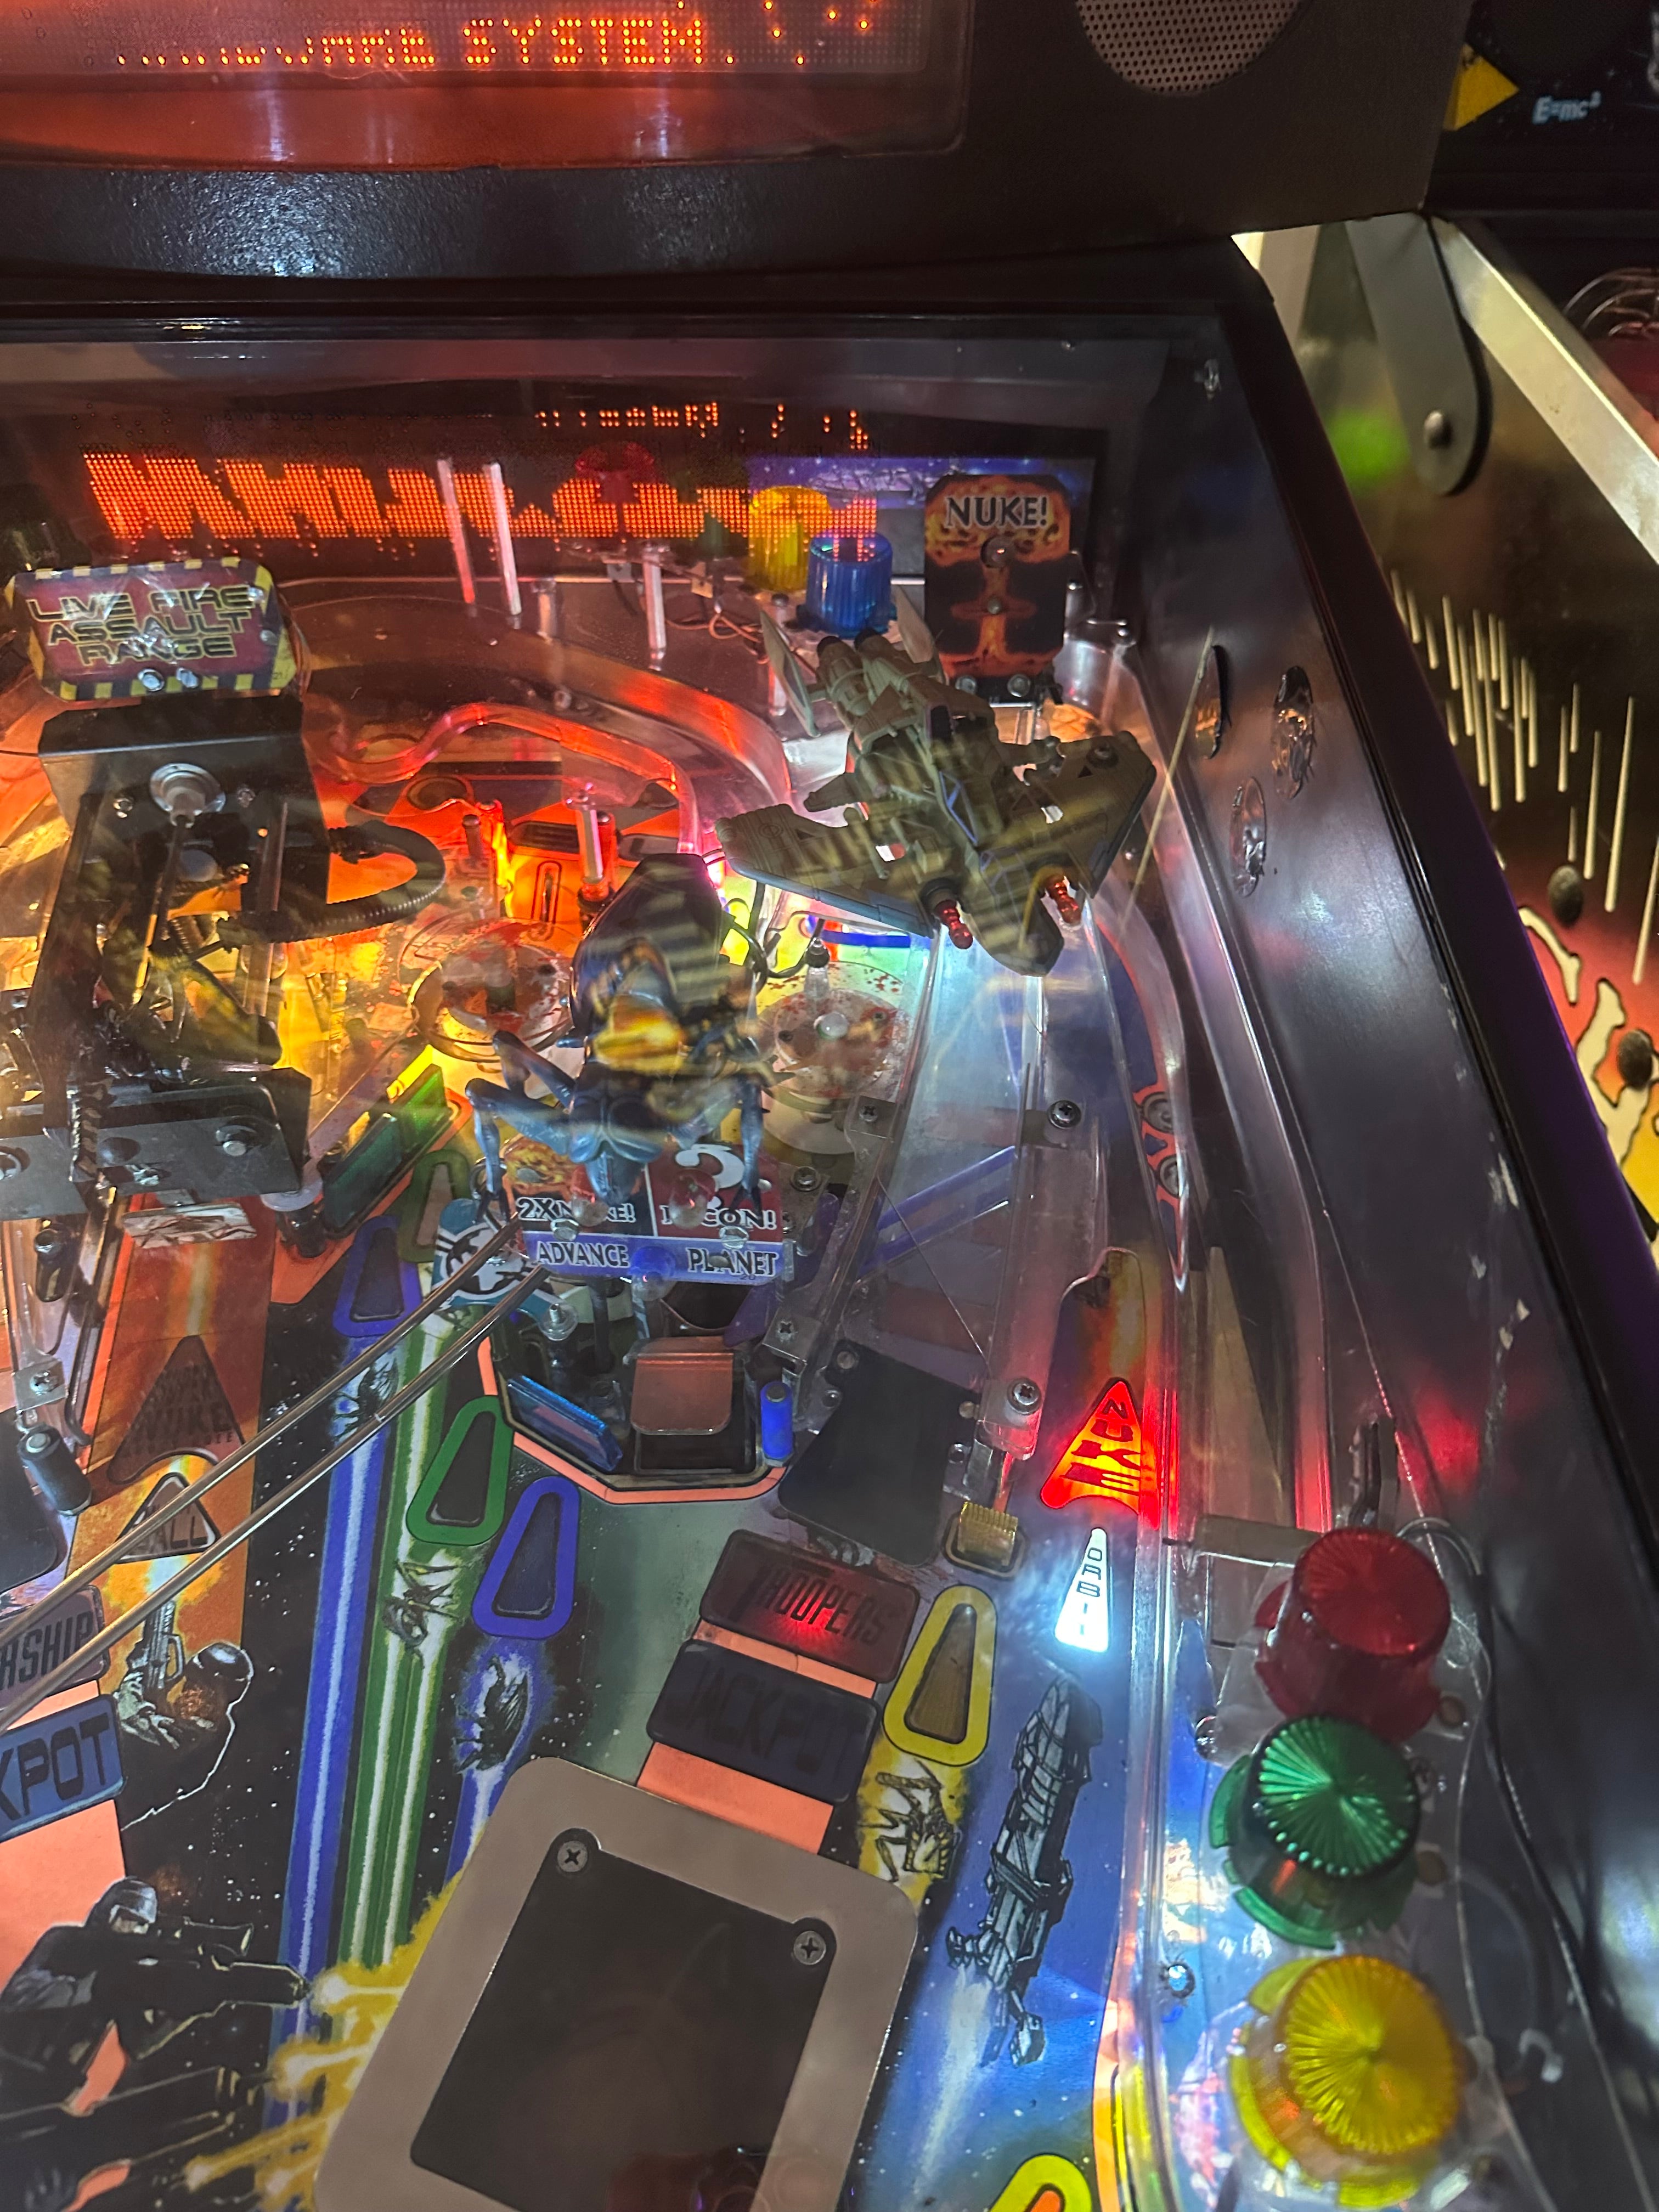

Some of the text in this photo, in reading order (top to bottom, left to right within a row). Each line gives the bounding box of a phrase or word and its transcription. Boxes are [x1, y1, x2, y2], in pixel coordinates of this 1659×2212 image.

[945, 495, 1048, 528] NUKE!
[26, 584, 256, 622] LIVE FIRE
[48, 610, 252, 646] ASSAULT
[76, 634, 238, 666] RANGE
[659, 1204, 777, 1230] CON!
[535, 1240, 779, 1277] ADVANCE PLANET
